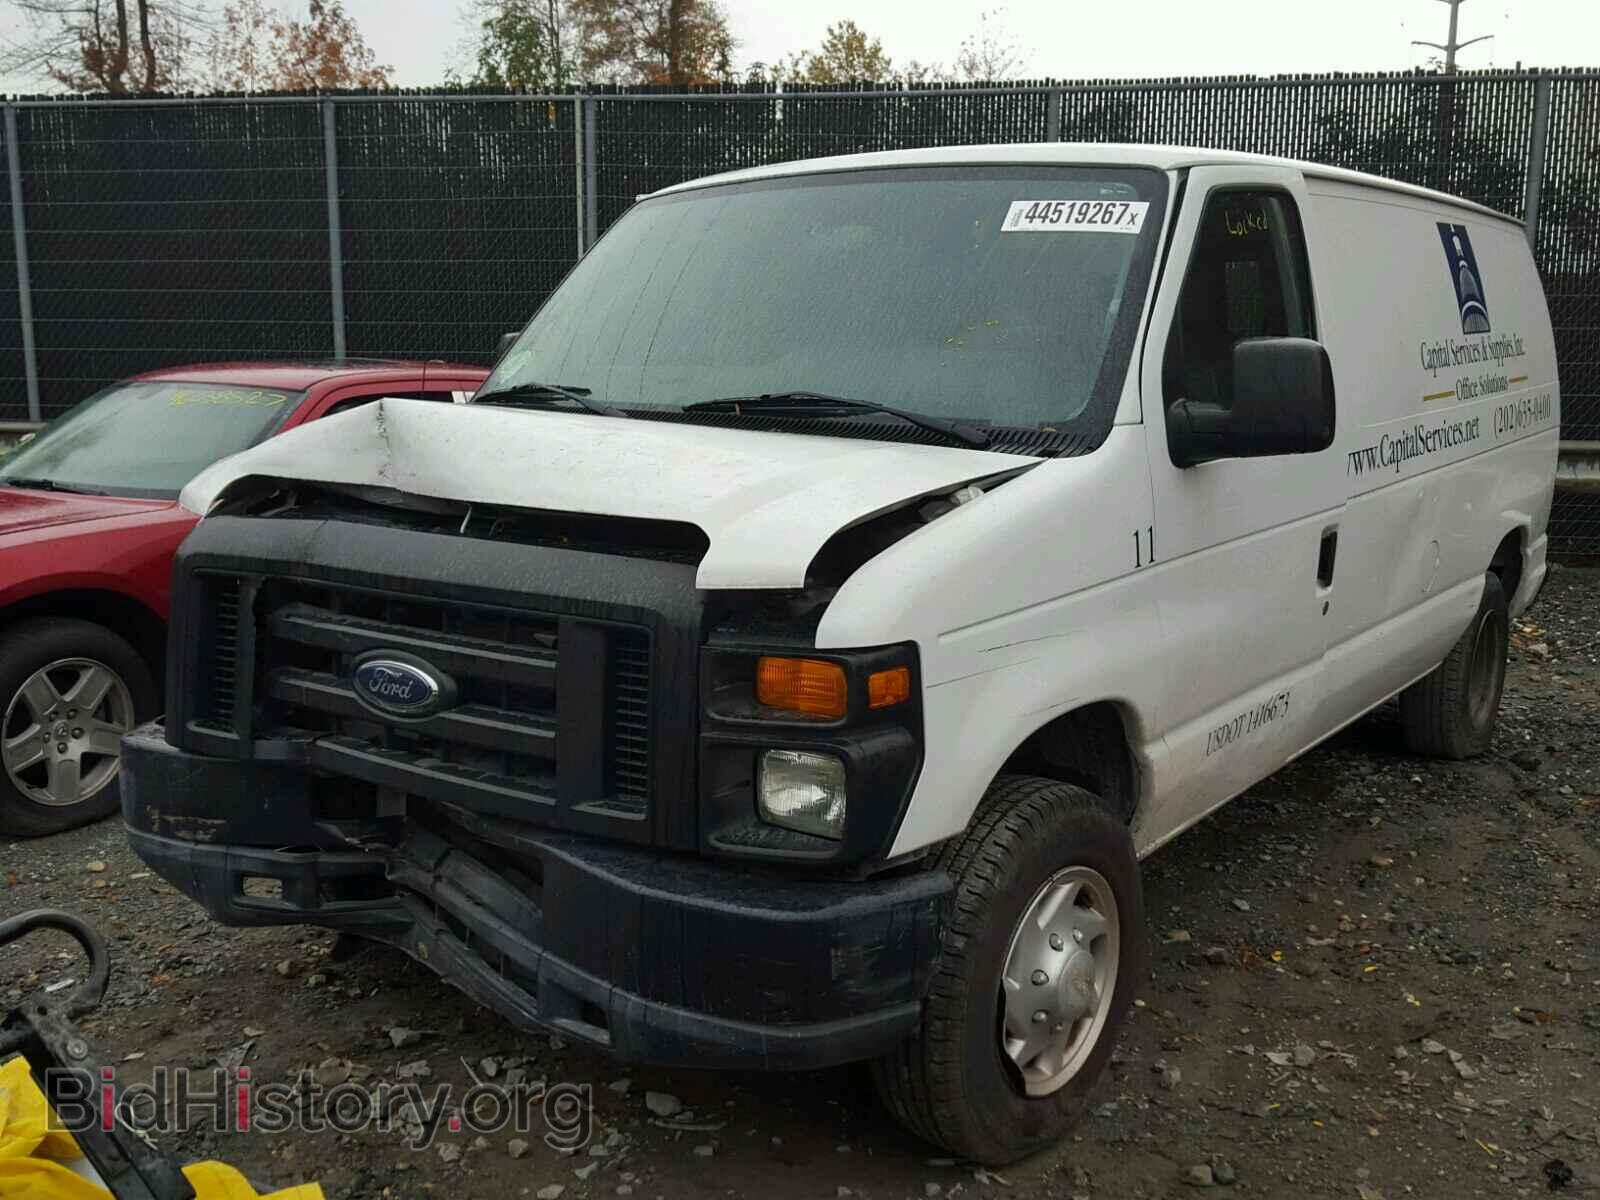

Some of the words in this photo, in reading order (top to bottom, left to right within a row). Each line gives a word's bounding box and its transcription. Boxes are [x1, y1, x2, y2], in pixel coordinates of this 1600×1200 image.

[1420, 341, 1450, 378] Capital
[1450, 338, 1480, 366] Services
[1456, 376, 1478, 401] Office
[1480, 373, 1508, 395] Solutions
[1132, 525, 1155, 569] 11
[368, 667, 414, 699] Ford
[1204, 712, 1247, 757] USDOT
